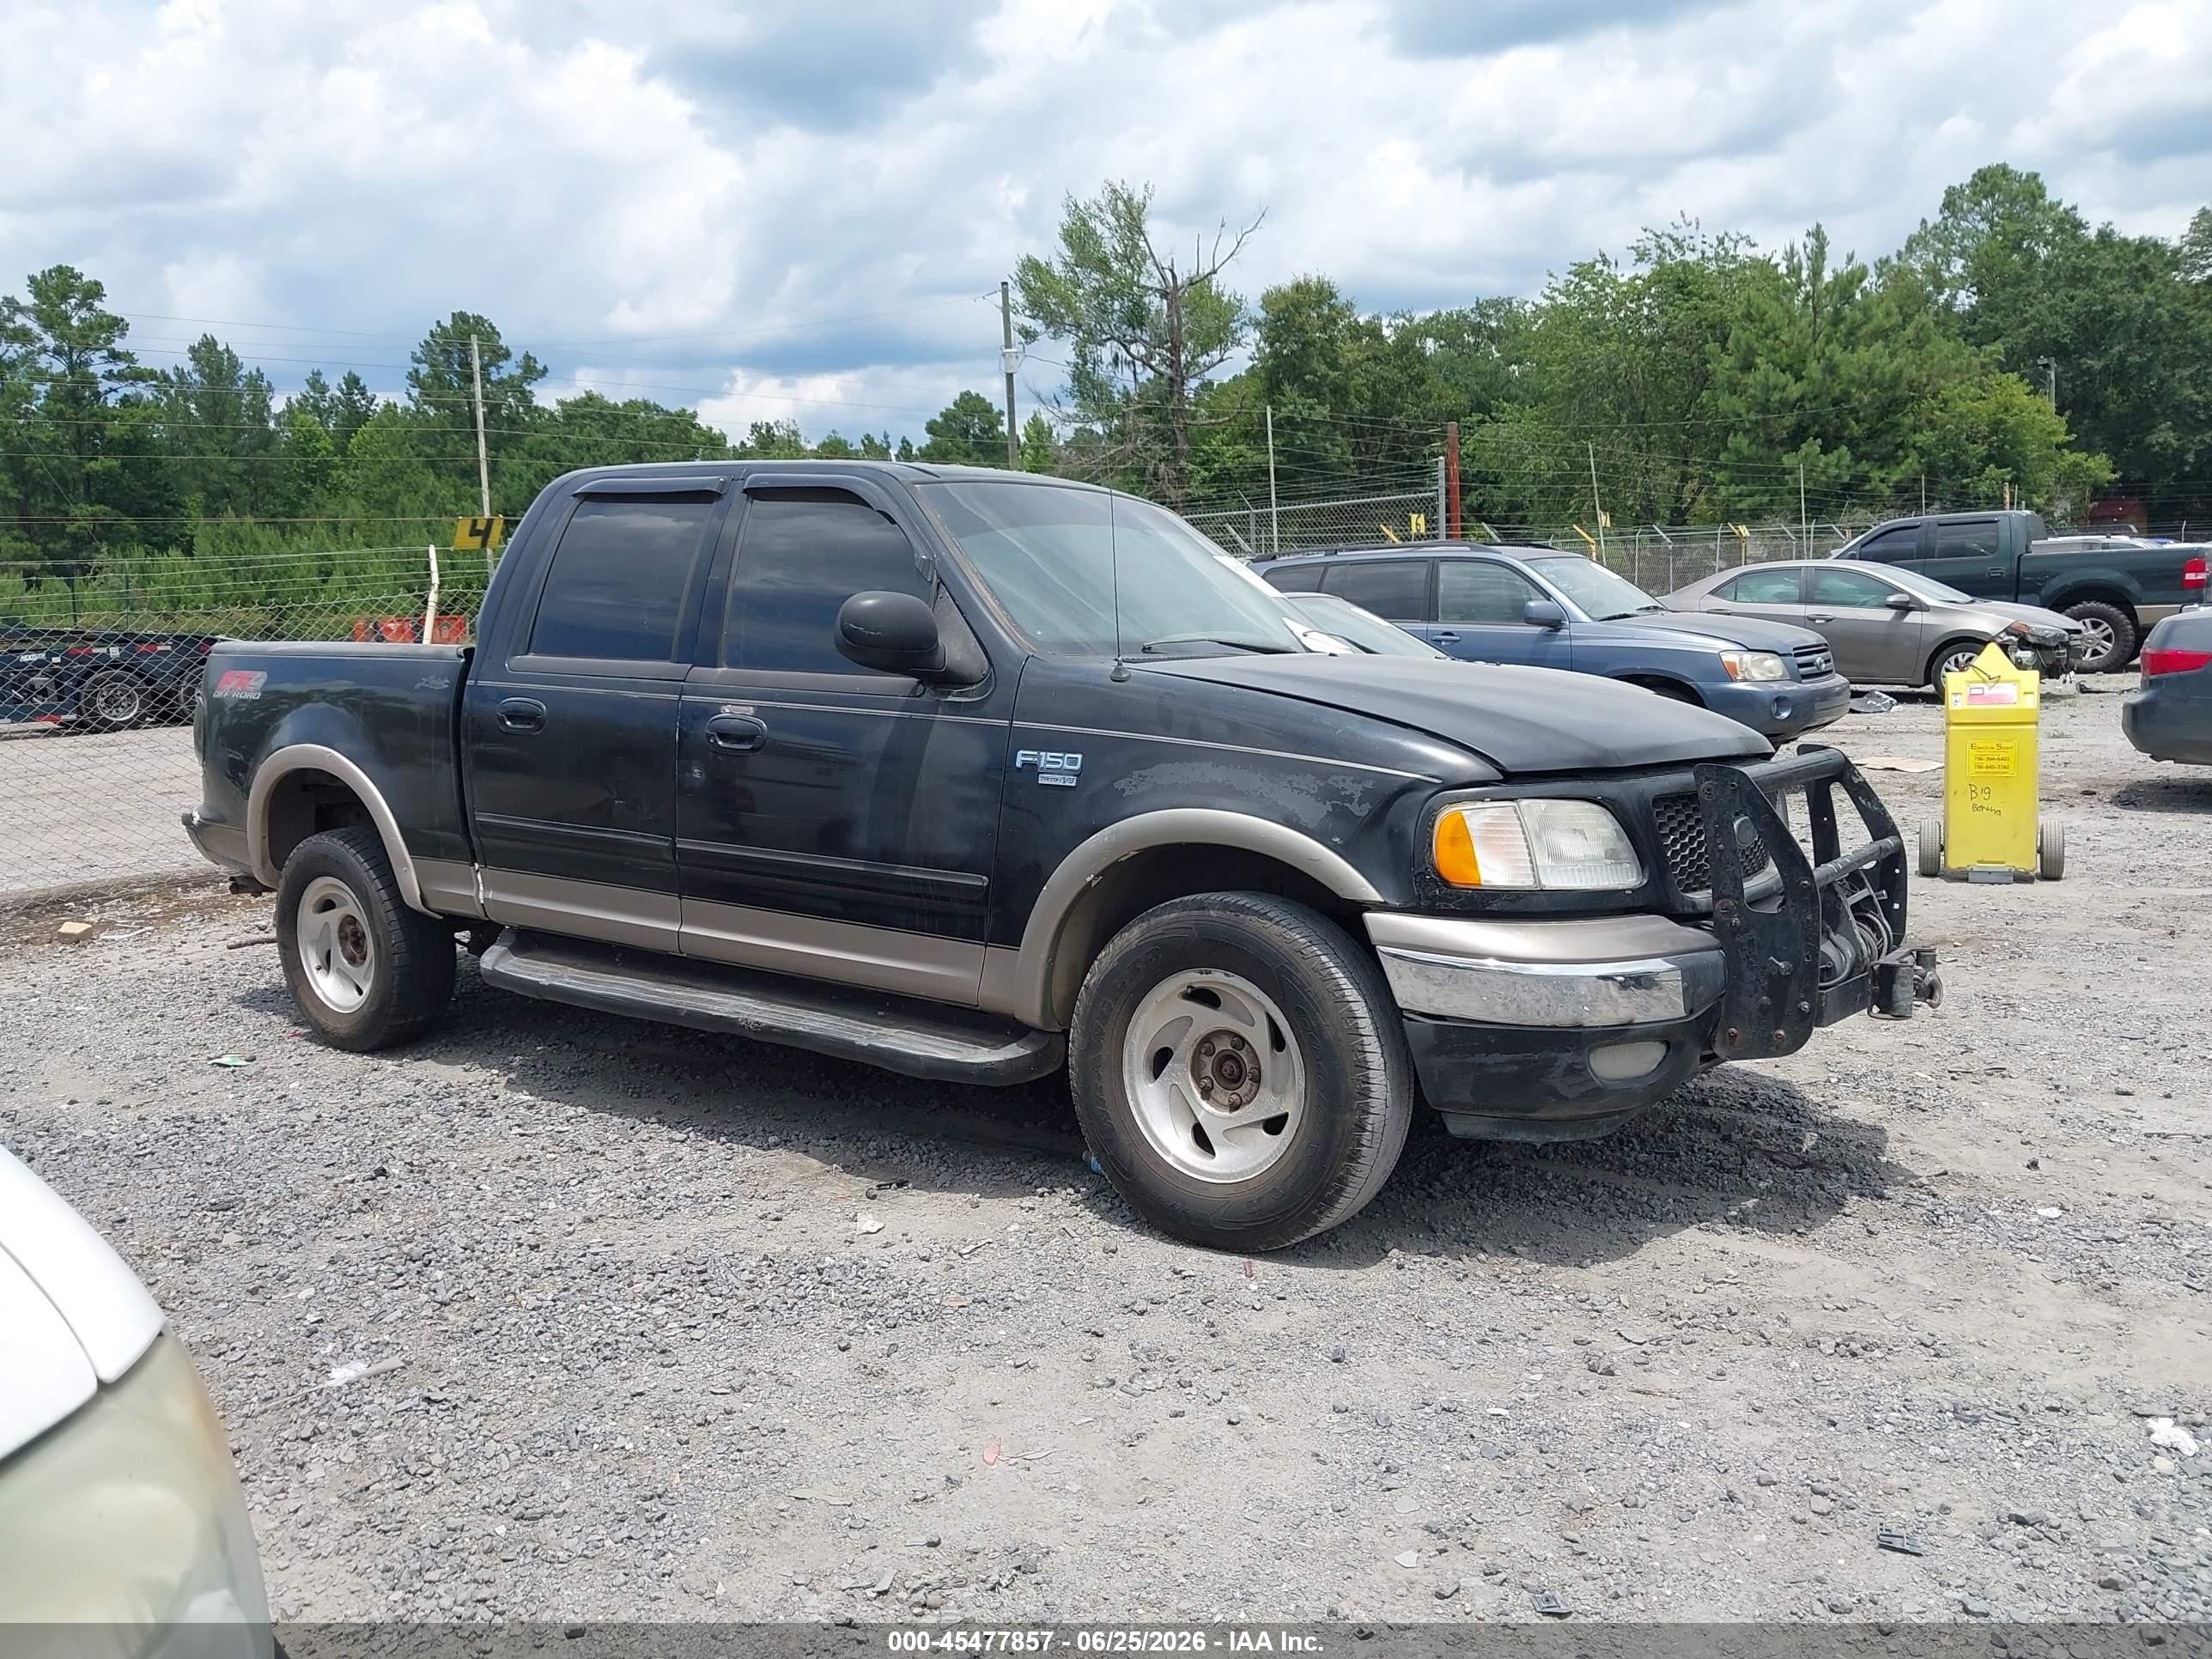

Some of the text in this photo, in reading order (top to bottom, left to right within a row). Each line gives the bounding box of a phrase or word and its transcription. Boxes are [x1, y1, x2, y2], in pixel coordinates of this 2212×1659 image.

[1416, 514, 1421, 532] 6
[469, 519, 495, 548] 4
[212, 690, 262, 700] OFF ROAD
[1968, 783, 1991, 801] Big
